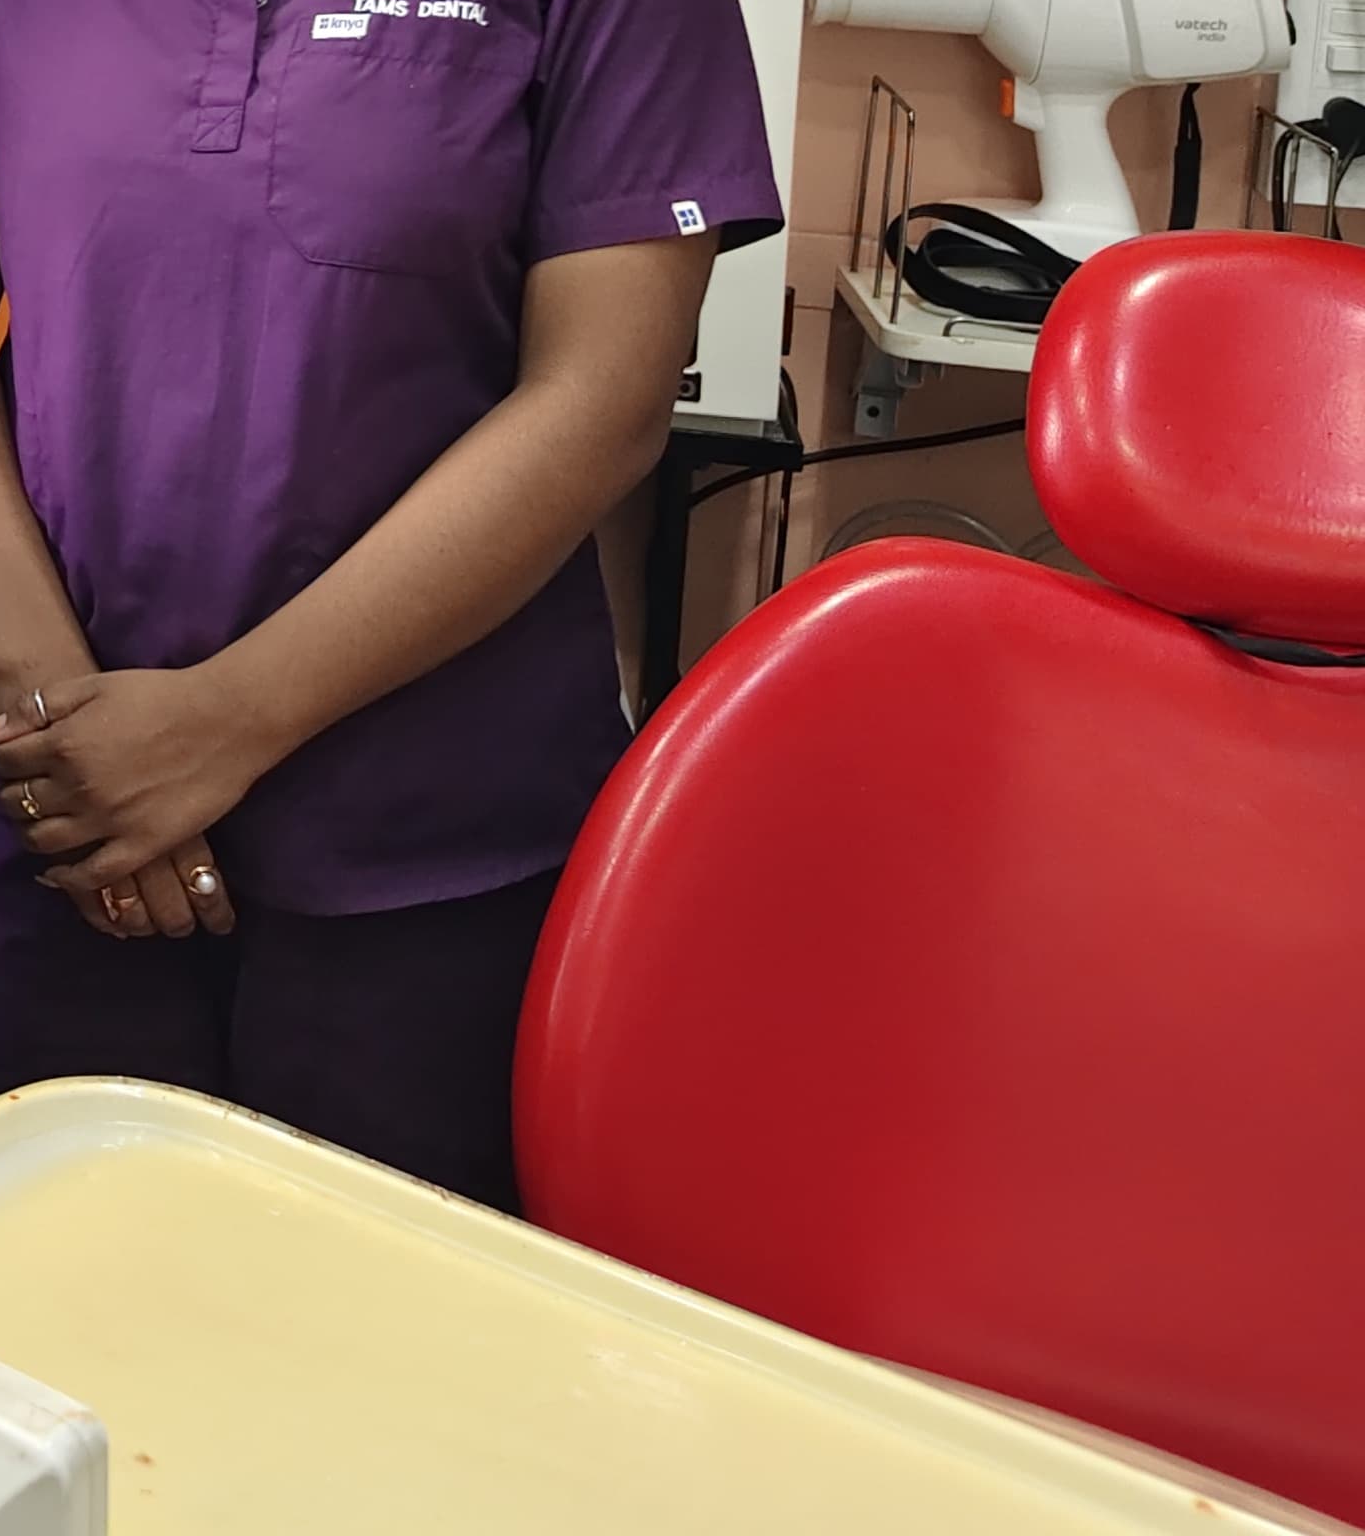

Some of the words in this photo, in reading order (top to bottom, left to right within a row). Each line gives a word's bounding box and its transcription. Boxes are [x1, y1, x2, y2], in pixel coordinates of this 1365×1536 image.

[417, 0, 490, 27] DENTAL
[331, 17, 364, 31] knya
[1174, 18, 1228, 31] vatech
